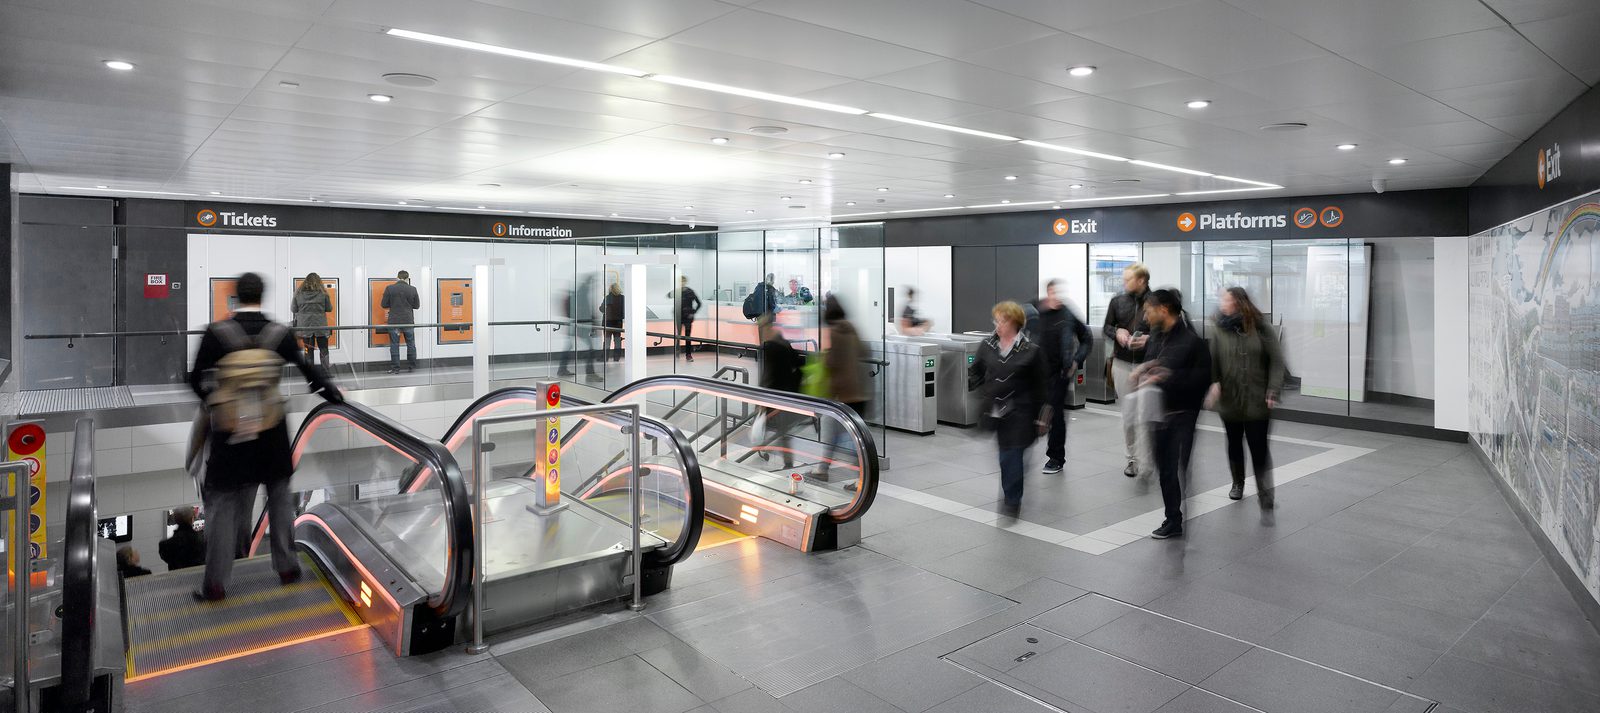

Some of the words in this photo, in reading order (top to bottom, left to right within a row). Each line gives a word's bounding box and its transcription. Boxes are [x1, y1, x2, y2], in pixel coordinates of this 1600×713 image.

[1546, 142, 1561, 182] Exit
[219, 212, 277, 227] Tickets
[1071, 218, 1097, 234] Exit
[1199, 211, 1287, 230] Platforms
[508, 224, 573, 238] Information
